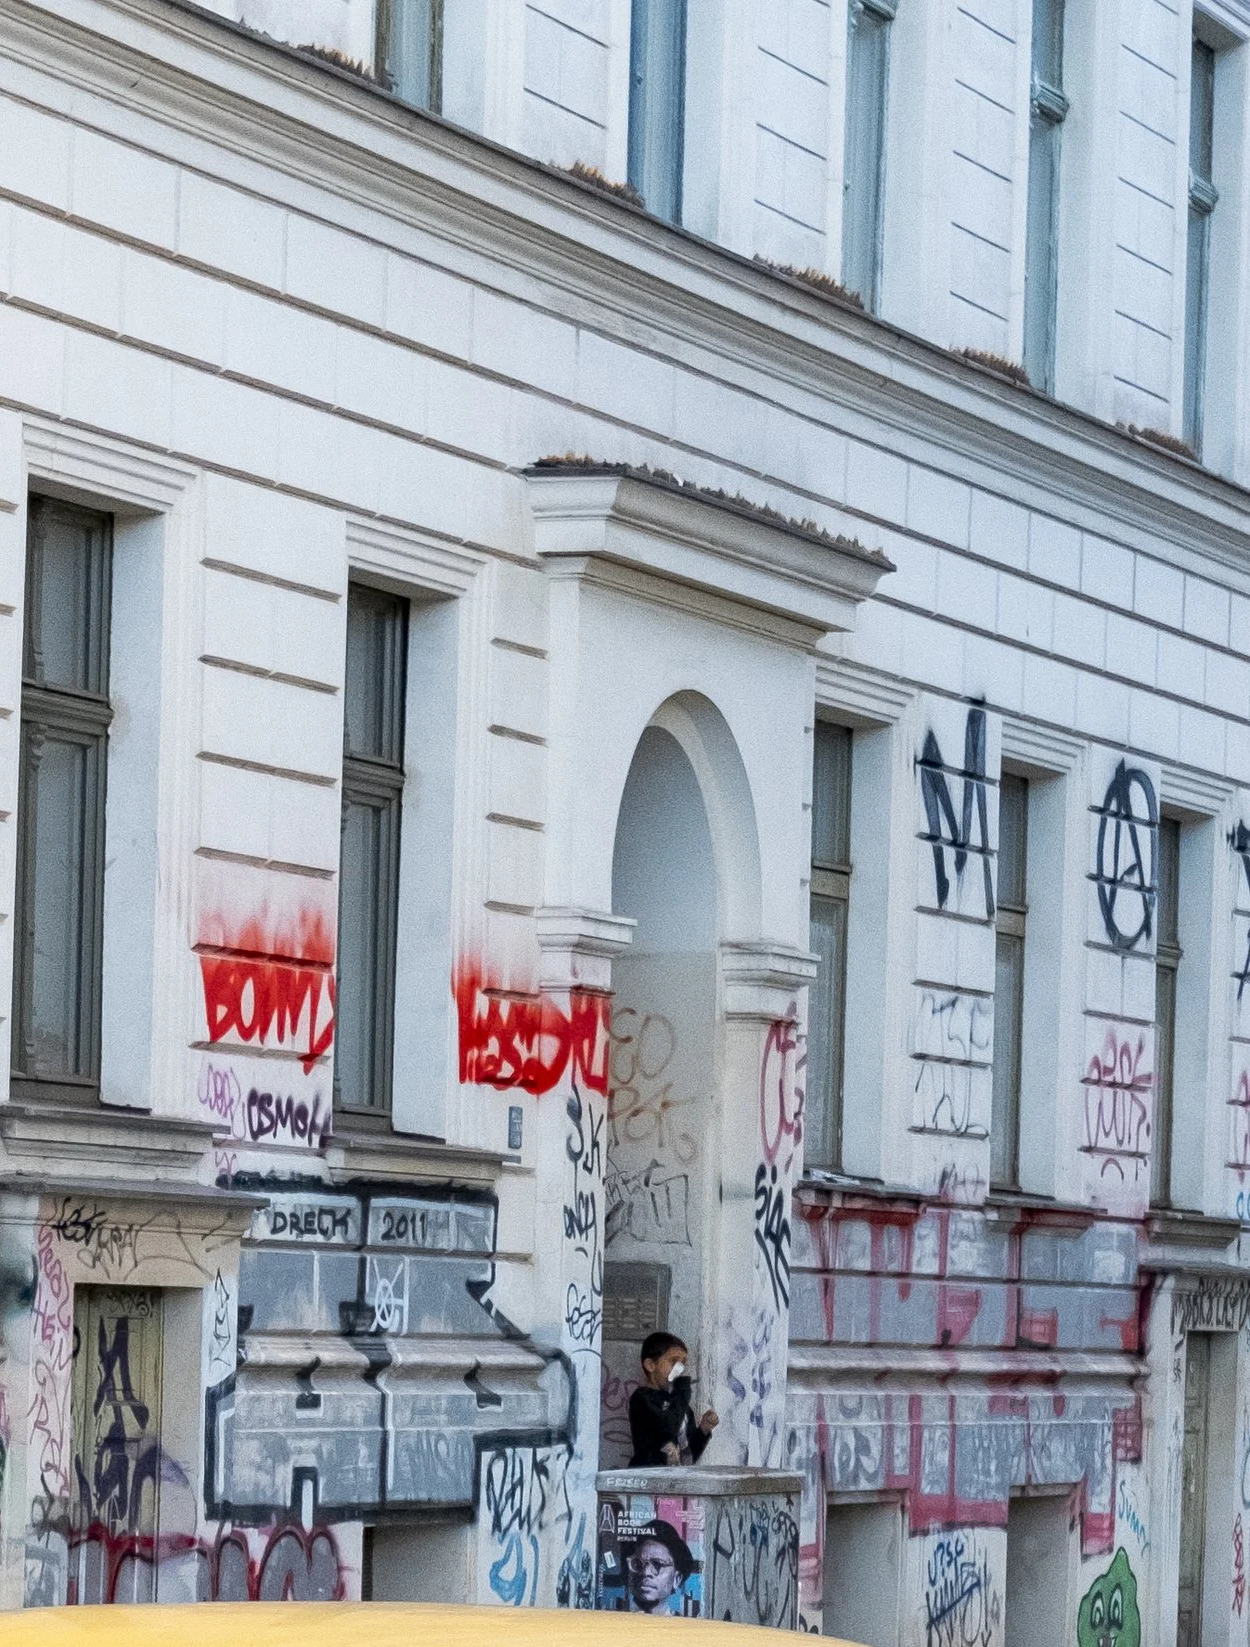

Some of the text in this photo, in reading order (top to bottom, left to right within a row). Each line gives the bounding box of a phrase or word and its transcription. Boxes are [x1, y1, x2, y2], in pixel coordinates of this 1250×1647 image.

[381, 1211, 427, 1241] 2011
[618, 1510, 657, 1519] AFRICAN
[617, 1527, 657, 1536] FESTIVAL
